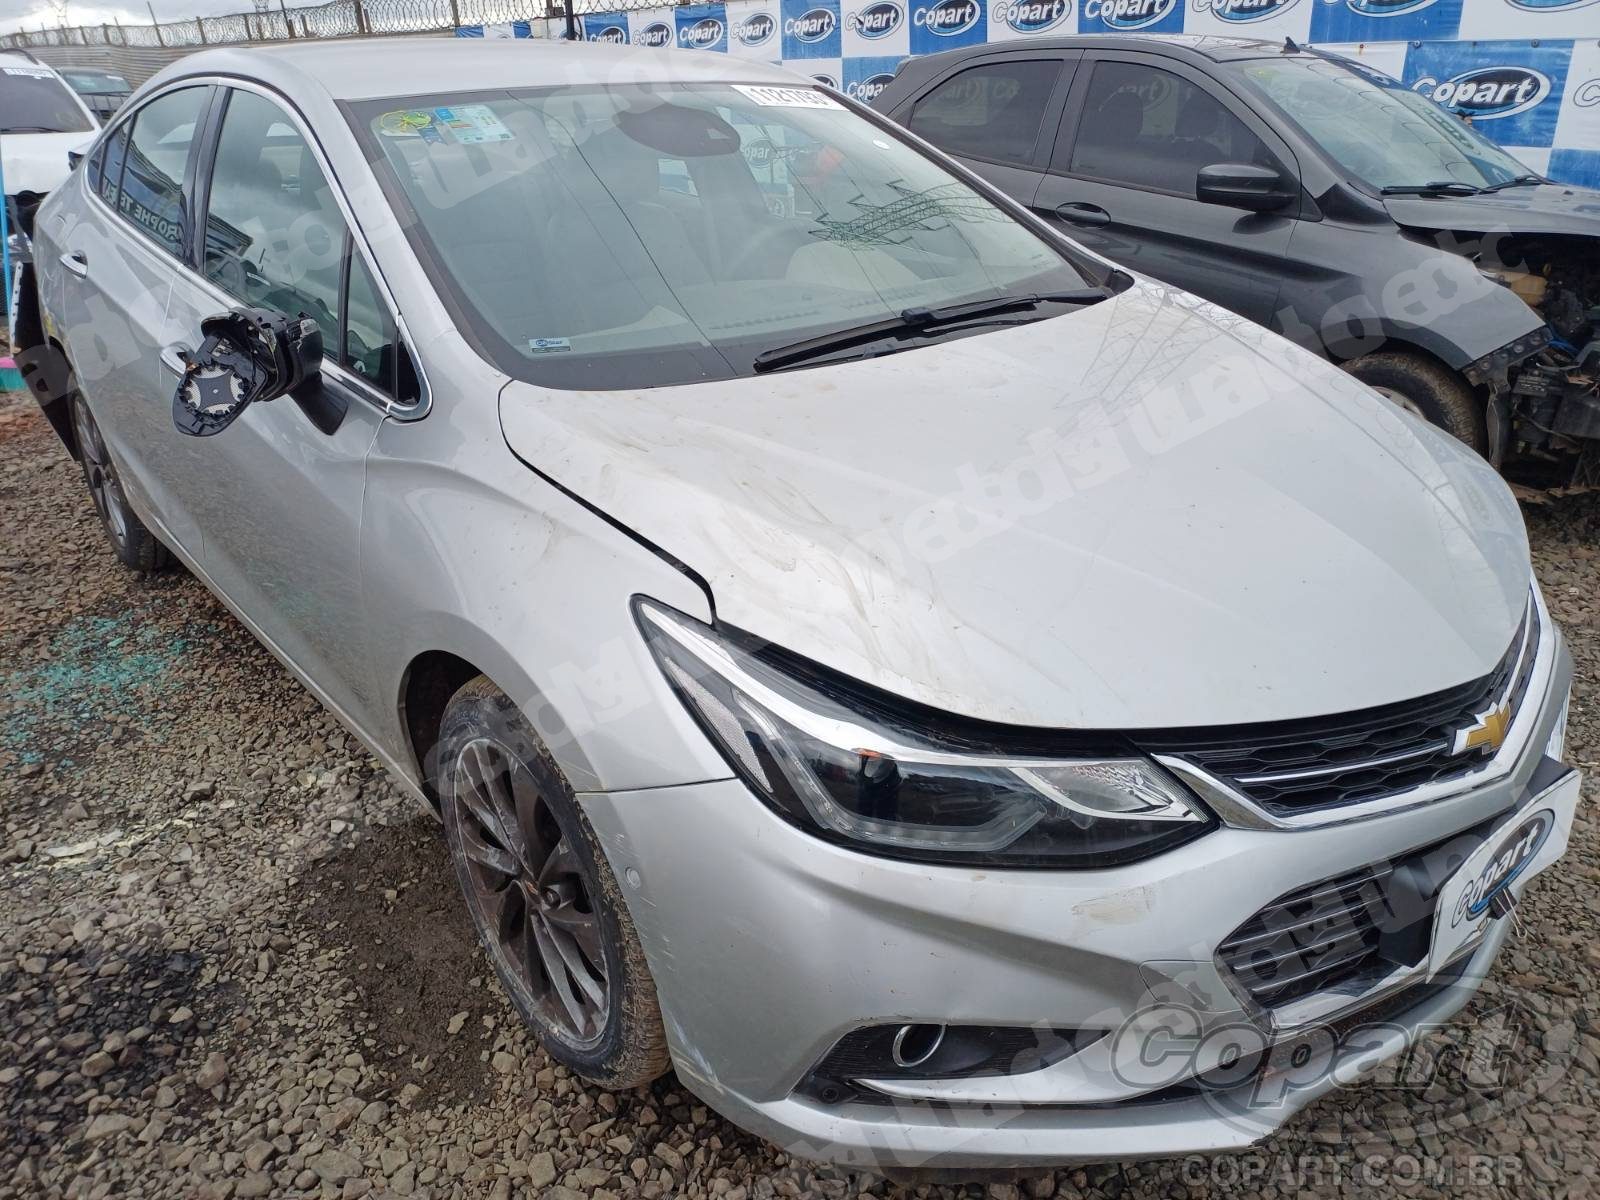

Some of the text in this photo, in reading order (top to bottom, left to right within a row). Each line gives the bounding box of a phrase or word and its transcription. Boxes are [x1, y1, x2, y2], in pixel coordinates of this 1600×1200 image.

[845, 9, 896, 33] Copart
[915, 0, 973, 28] Copart
[992, 0, 1060, 24] Copart
[1085, 0, 1163, 24] Copart
[680, 23, 719, 44] Copart
[731, 18, 771, 41] Copart
[785, 14, 830, 35] Copart
[633, 27, 668, 48] Copart
[847, 82, 889, 102] Copa
[1412, 76, 1534, 108] Copart
[1452, 822, 1538, 929] Copart
